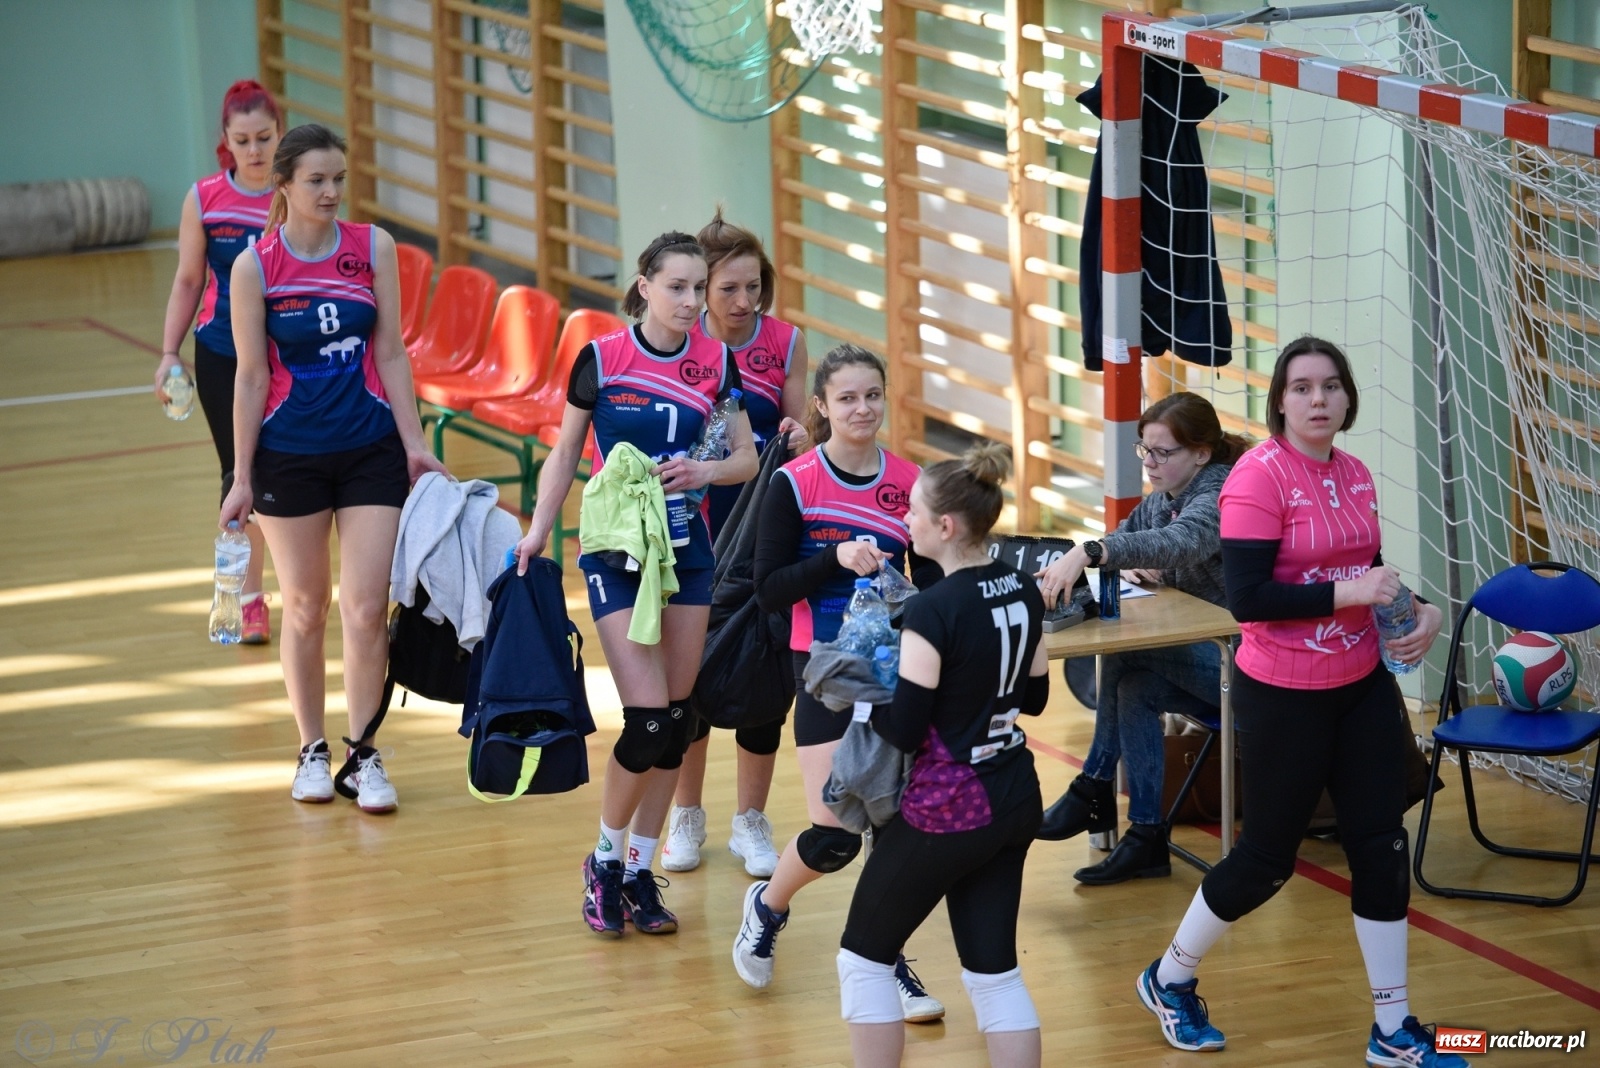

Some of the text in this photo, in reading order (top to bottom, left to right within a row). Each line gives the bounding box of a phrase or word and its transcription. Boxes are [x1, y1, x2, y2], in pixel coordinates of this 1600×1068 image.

[317, 302, 340, 335] 8
[655, 402, 678, 443] 7
[796, 459, 816, 473] COLO
[1322, 479, 1340, 508] 3
[588, 573, 607, 604] 7
[978, 572, 1023, 599] ZAJONC
[991, 600, 1029, 697] 17
[1549, 667, 1573, 692] RLPS
